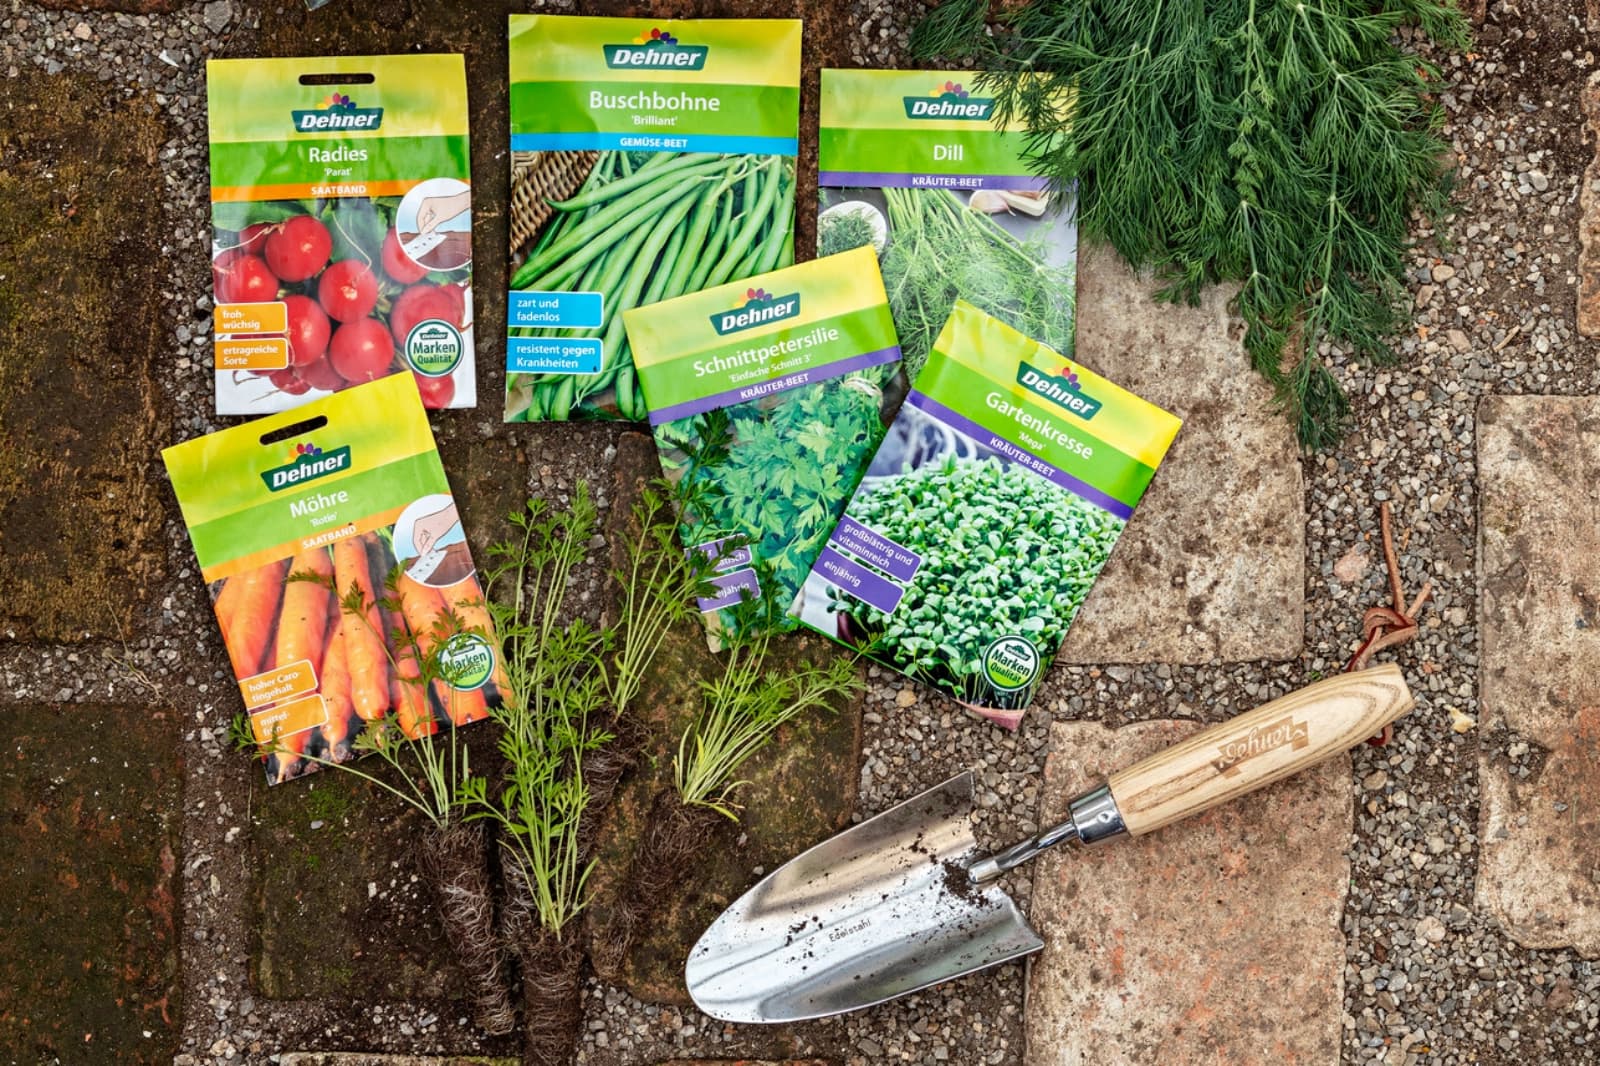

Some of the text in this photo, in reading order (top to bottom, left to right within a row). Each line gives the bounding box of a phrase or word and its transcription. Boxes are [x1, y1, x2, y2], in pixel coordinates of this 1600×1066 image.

[612, 49, 702, 66] Dehner
[589, 90, 720, 111] Buschbohne
[912, 101, 987, 117] Dehner
[301, 112, 377, 129] Dehner
[631, 116, 678, 126] 'Brilliant'
[620, 136, 688, 148] GEMÜSE-BEET
[309, 147, 368, 163] Radies
[934, 145, 963, 161] Dill
[324, 167, 353, 176] 'Parat'
[311, 185, 367, 195] SAATBAND
[912, 176, 984, 187] KRÄUTER-BEET
[517, 299, 559, 308] zart und
[517, 312, 560, 321] fadenlos
[721, 299, 796, 331] Dehner
[223, 320, 261, 330] wüchsig
[223, 345, 278, 355] ertragreiche
[413, 342, 456, 354] Marken
[516, 344, 595, 357] resistent gegen
[693, 328, 839, 377] Schnittpetersilie
[224, 356, 248, 365] Sorte
[417, 354, 452, 365] Qualität
[516, 357, 578, 368] Krankheiten
[771, 357, 803, 373] Schnitt
[740, 373, 809, 400] KRÄUTER-BEET
[1021, 370, 1095, 414] Dehner
[986, 392, 1093, 460] Gartenkresse
[1019, 431, 1046, 450] 'Mega'
[990, 437, 1055, 477] KRÄUTER-BEET
[272, 453, 346, 487] Dehner
[289, 490, 349, 518] Möhre
[303, 524, 356, 549] SAATBAND
[843, 523, 912, 566] großblättrig und
[838, 534, 890, 568] vitaminreich
[824, 560, 861, 587] einjährig
[992, 649, 1030, 677] Marken
[991, 662, 1021, 683] Qualität
[248, 679, 275, 692] hoher
[252, 684, 293, 702] tingehalt
[829, 919, 871, 941] Edelstahl
